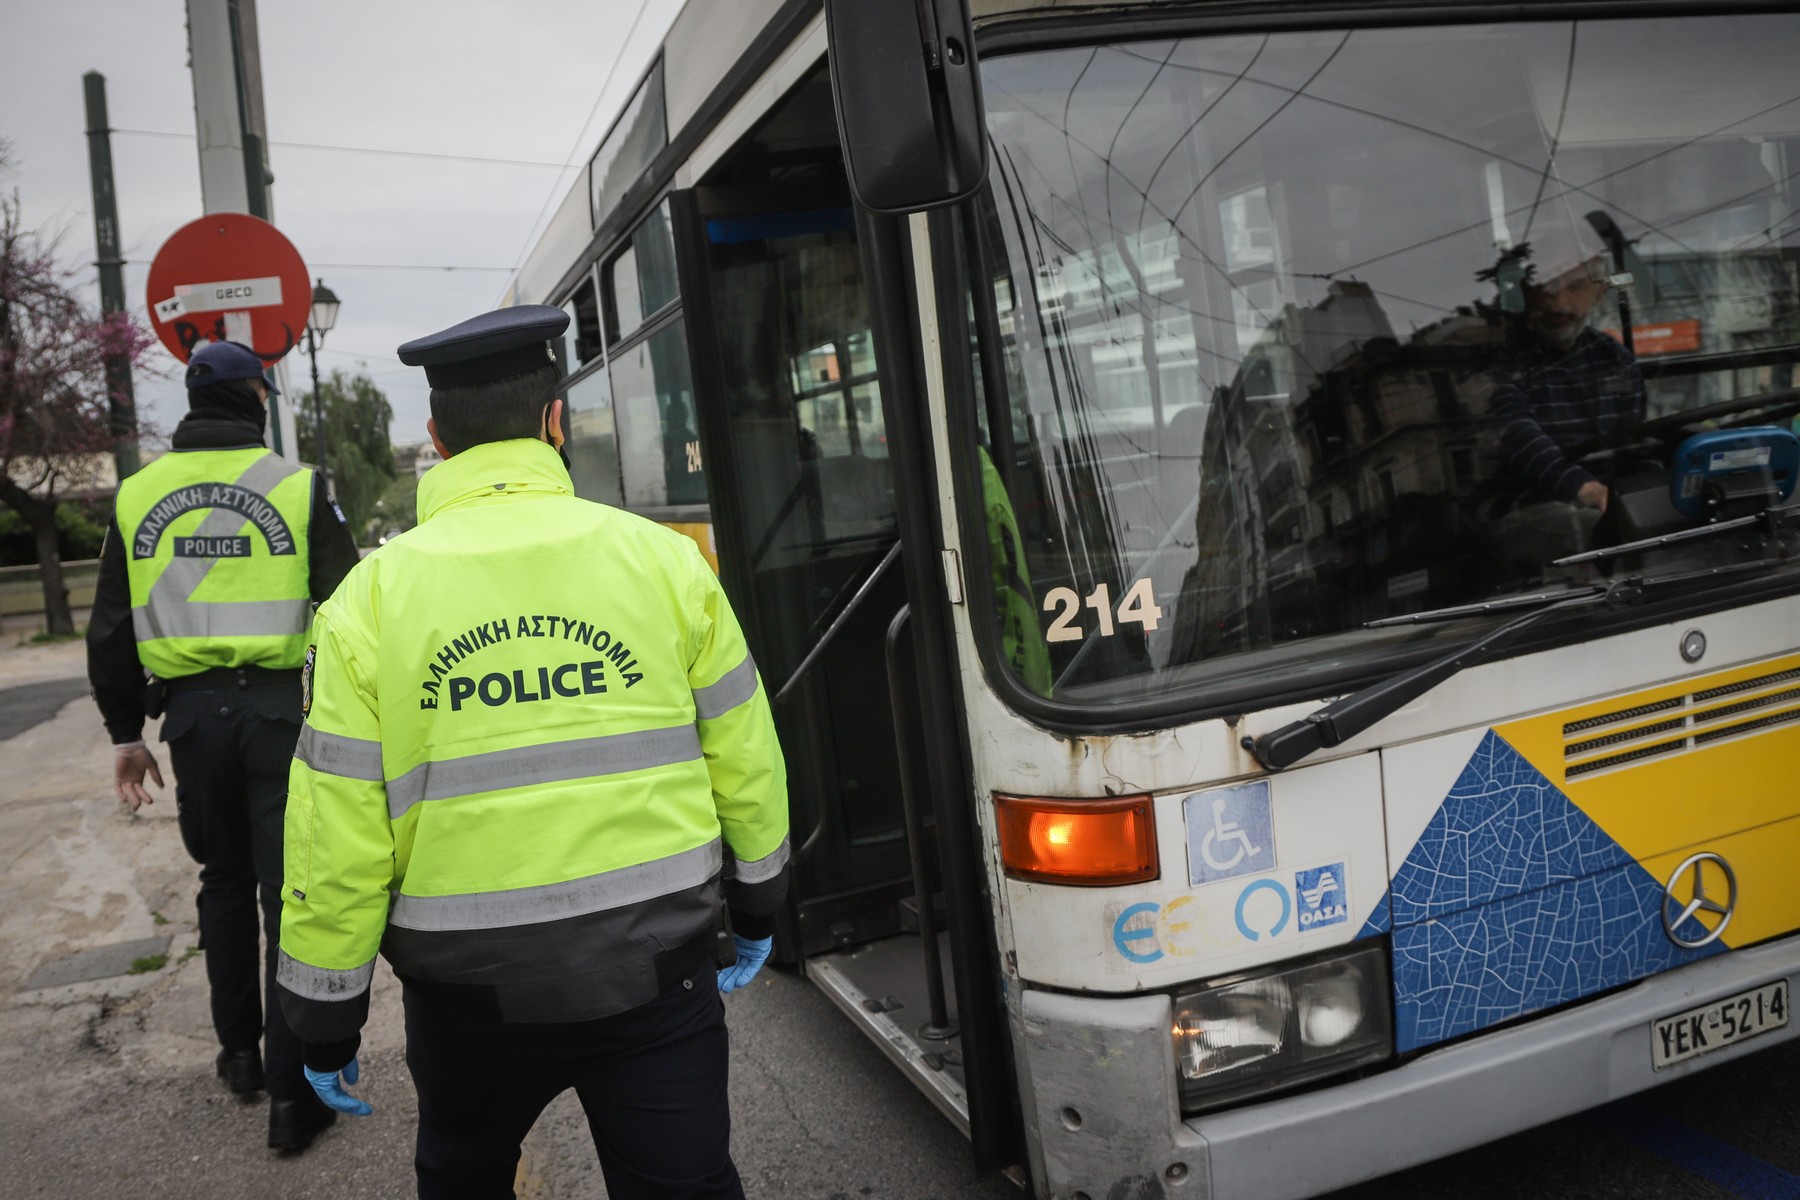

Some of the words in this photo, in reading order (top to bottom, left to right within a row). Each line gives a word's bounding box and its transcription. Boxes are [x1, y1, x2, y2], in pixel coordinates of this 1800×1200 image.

[136, 488, 202, 557] ΕΛΛΗΝΙΚΗ
[210, 486, 291, 555] ΑΣΤΥΝΟΜΙΑ
[184, 538, 242, 555] POLICE
[1043, 577, 1162, 643] 214
[420, 618, 511, 710] ΕΛΛΗΝΙΚΗ
[516, 615, 644, 689] ΑΣΤΥΝΟΜΙΑ
[448, 660, 608, 712] POLICE
[1300, 904, 1346, 925] ΟΑΣΑ
[1658, 987, 1785, 1059] YEK-5214
